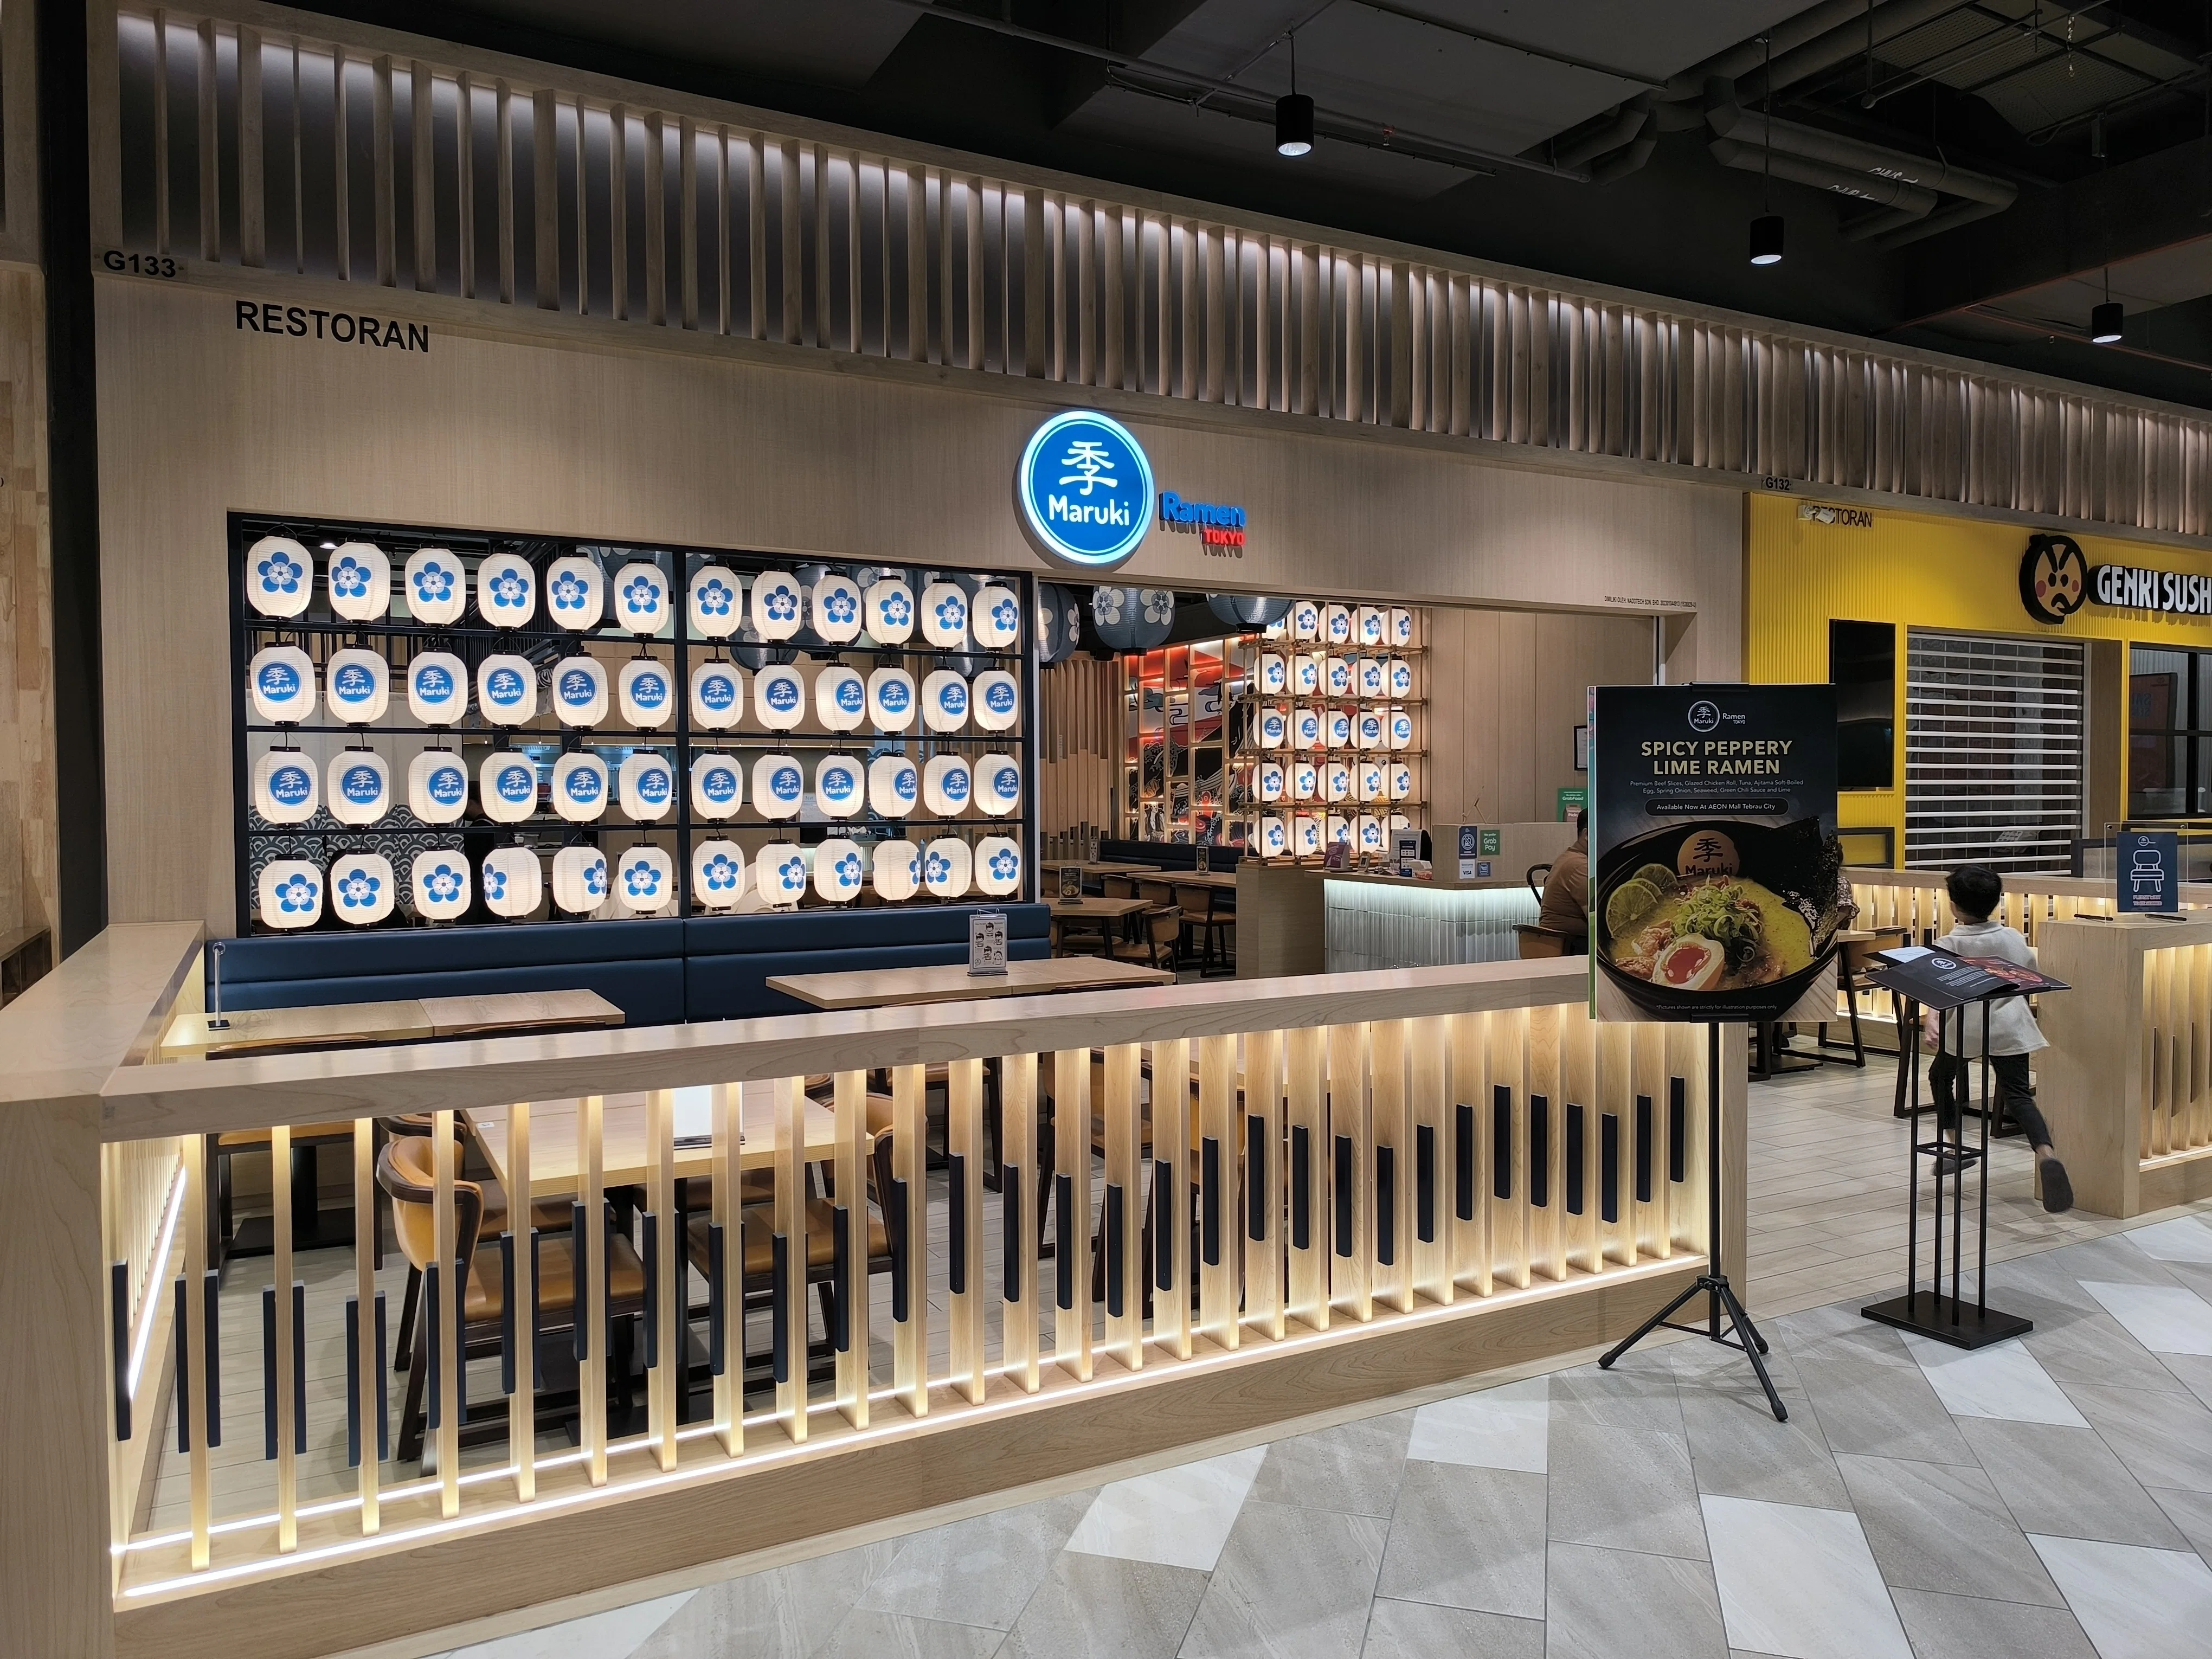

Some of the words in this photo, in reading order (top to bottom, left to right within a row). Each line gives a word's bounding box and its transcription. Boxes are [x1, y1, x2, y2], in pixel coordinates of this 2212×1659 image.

[103, 250, 176, 278] G133
[236, 300, 428, 353] RESTORAN
[1059, 441, 1118, 496] 季
[1765, 477, 1790, 491] G132
[1048, 494, 1129, 526] Maruki
[1162, 491, 1245, 527] Ramen
[1205, 529, 1245, 545] TOKYO
[2097, 565, 2159, 609] GENKI
[266, 667, 290, 685] 季
[342, 670, 365, 686] 季
[423, 670, 444, 687] 季
[494, 673, 516, 690] 季
[567, 674, 587, 691] 季
[263, 684, 296, 694] Maruki
[339, 686, 370, 695] Maruki
[420, 687, 450, 696] Maruki
[639, 678, 659, 693] 季
[708, 680, 727, 695] 季
[774, 682, 793, 697] 季
[844, 684, 859, 698] 季
[886, 684, 903, 698] 季
[492, 689, 522, 698] Maruki
[564, 690, 592, 699] Maruki
[705, 695, 731, 703] Maruki
[947, 687, 962, 701] 季
[993, 686, 1009, 700] 季
[771, 696, 796, 705] Maruki
[841, 698, 862, 706] Maruki
[944, 700, 965, 708] Maruki
[991, 699, 1013, 707] Maruki
[1697, 706, 1711, 718] 季
[1641, 741, 1699, 756] SPICY
[1705, 741, 1792, 755] PEPPERY
[1654, 760, 1700, 775] LIME
[1707, 760, 1779, 774] RAMEN
[280, 771, 303, 788] 季
[351, 771, 374, 787] 季
[438, 772, 459, 790] 季
[506, 770, 527, 787] 季
[574, 771, 595, 788] 季
[646, 773, 664, 788] 季
[711, 773, 730, 788] 季
[780, 771, 796, 786] 季
[828, 772, 846, 786] 季
[902, 773, 914, 787] 季
[950, 773, 965, 787] 季
[1001, 771, 1015, 786] 季
[276, 787, 307, 798] Maruki
[348, 787, 378, 796] Maruki
[434, 788, 462, 798] Maruki
[503, 786, 531, 795] Maruki
[571, 787, 599, 796] Maruki
[642, 788, 668, 796] Maruki
[708, 787, 734, 796] Maruki
[776, 786, 799, 794] Maruki
[826, 786, 851, 794] Maruki
[947, 785, 967, 794] Maruki
[1693, 838, 1723, 862] 季
[1685, 863, 1733, 876] Maruki
